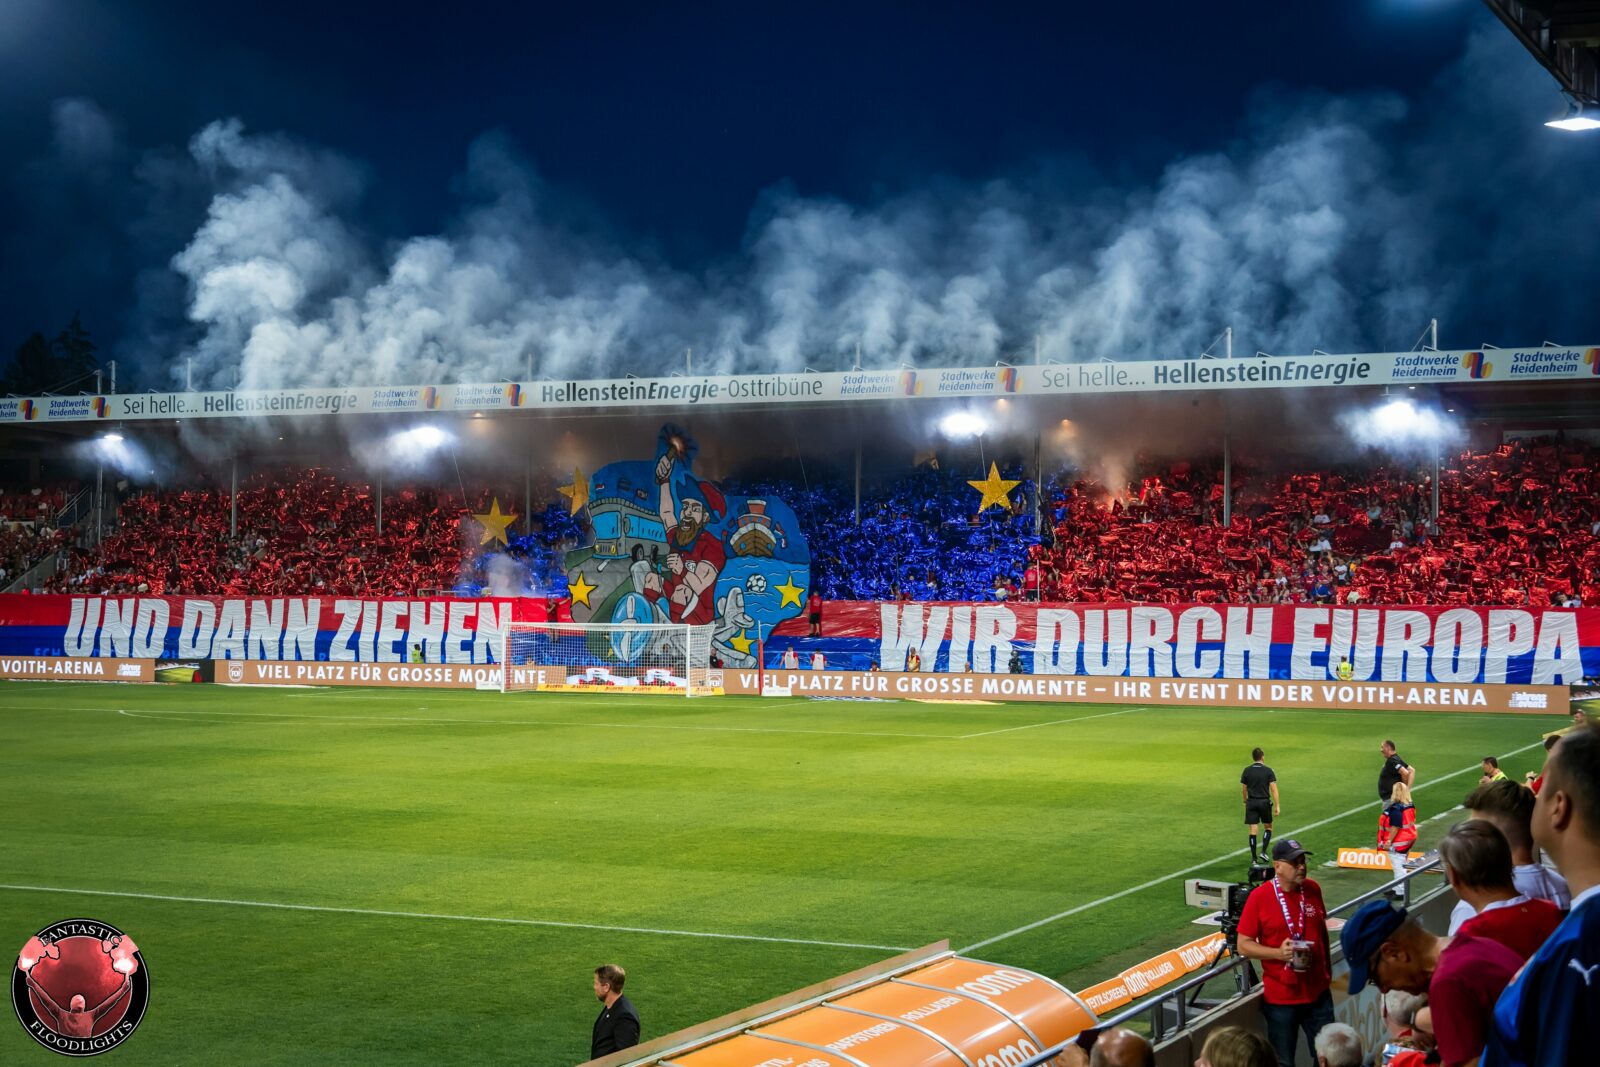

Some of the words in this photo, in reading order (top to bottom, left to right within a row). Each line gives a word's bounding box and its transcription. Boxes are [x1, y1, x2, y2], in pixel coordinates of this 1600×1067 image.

[1395, 353, 1459, 366] Stadtwerke
[1513, 350, 1580, 363] Stadtwerke
[1042, 368, 1071, 388] Sei
[1079, 365, 1146, 386] helle...
[1154, 358, 1370, 384] HellensteinEnergie
[1392, 365, 1457, 377] Heidenheim
[1510, 362, 1578, 374] Heidenheim
[843, 374, 896, 385] Stadtwerke
[941, 370, 996, 381] Stadtwerke
[456, 386, 503, 396] Stadtwerke
[542, 377, 823, 403] HellensteinEnergie-Osttribüne
[840, 384, 894, 394] Heidenheim
[939, 380, 994, 391] Heidenheim
[374, 389, 419, 398] Stadtwerke
[454, 395, 501, 405] Heidenheim
[50, 398, 91, 408] Stadtwerke
[123, 398, 144, 414] Sei
[150, 395, 198, 414] helle...
[204, 391, 358, 413] HellensteinEnergie
[372, 397, 417, 407] Heidenheim
[48, 407, 89, 417] Heidenheim
[64, 598, 170, 659] UND
[178, 599, 321, 662] DANN
[330, 601, 513, 665] ZIEHEN
[880, 603, 1018, 674] WIR
[1033, 606, 1273, 680] DURCH
[1291, 608, 1584, 685] EUROPA
[2, 660, 104, 675] VOITH-ARENA
[257, 664, 291, 679] VIEL
[299, 665, 345, 680] PLATZ
[350, 663, 381, 681] FÜR
[388, 666, 452, 683] GROSSE
[740, 673, 778, 689] VIEL
[788, 675, 843, 690] PLATZ
[851, 672, 888, 692] FÜR
[896, 676, 973, 694] GROSSE
[982, 679, 1087, 696] MOMENTE
[1114, 681, 1153, 698] IHR
[1160, 682, 1229, 700] EVENT
[1238, 684, 1261, 700] IN
[1271, 685, 1314, 702] DER
[1323, 686, 1488, 706] VOITH-ARENA
[1339, 851, 1387, 866] roma
[1179, 946, 1206, 969] roma
[956, 969, 1035, 999] roma
[1123, 970, 1150, 995] roma
[900, 995, 963, 1022] ROLLADEN
